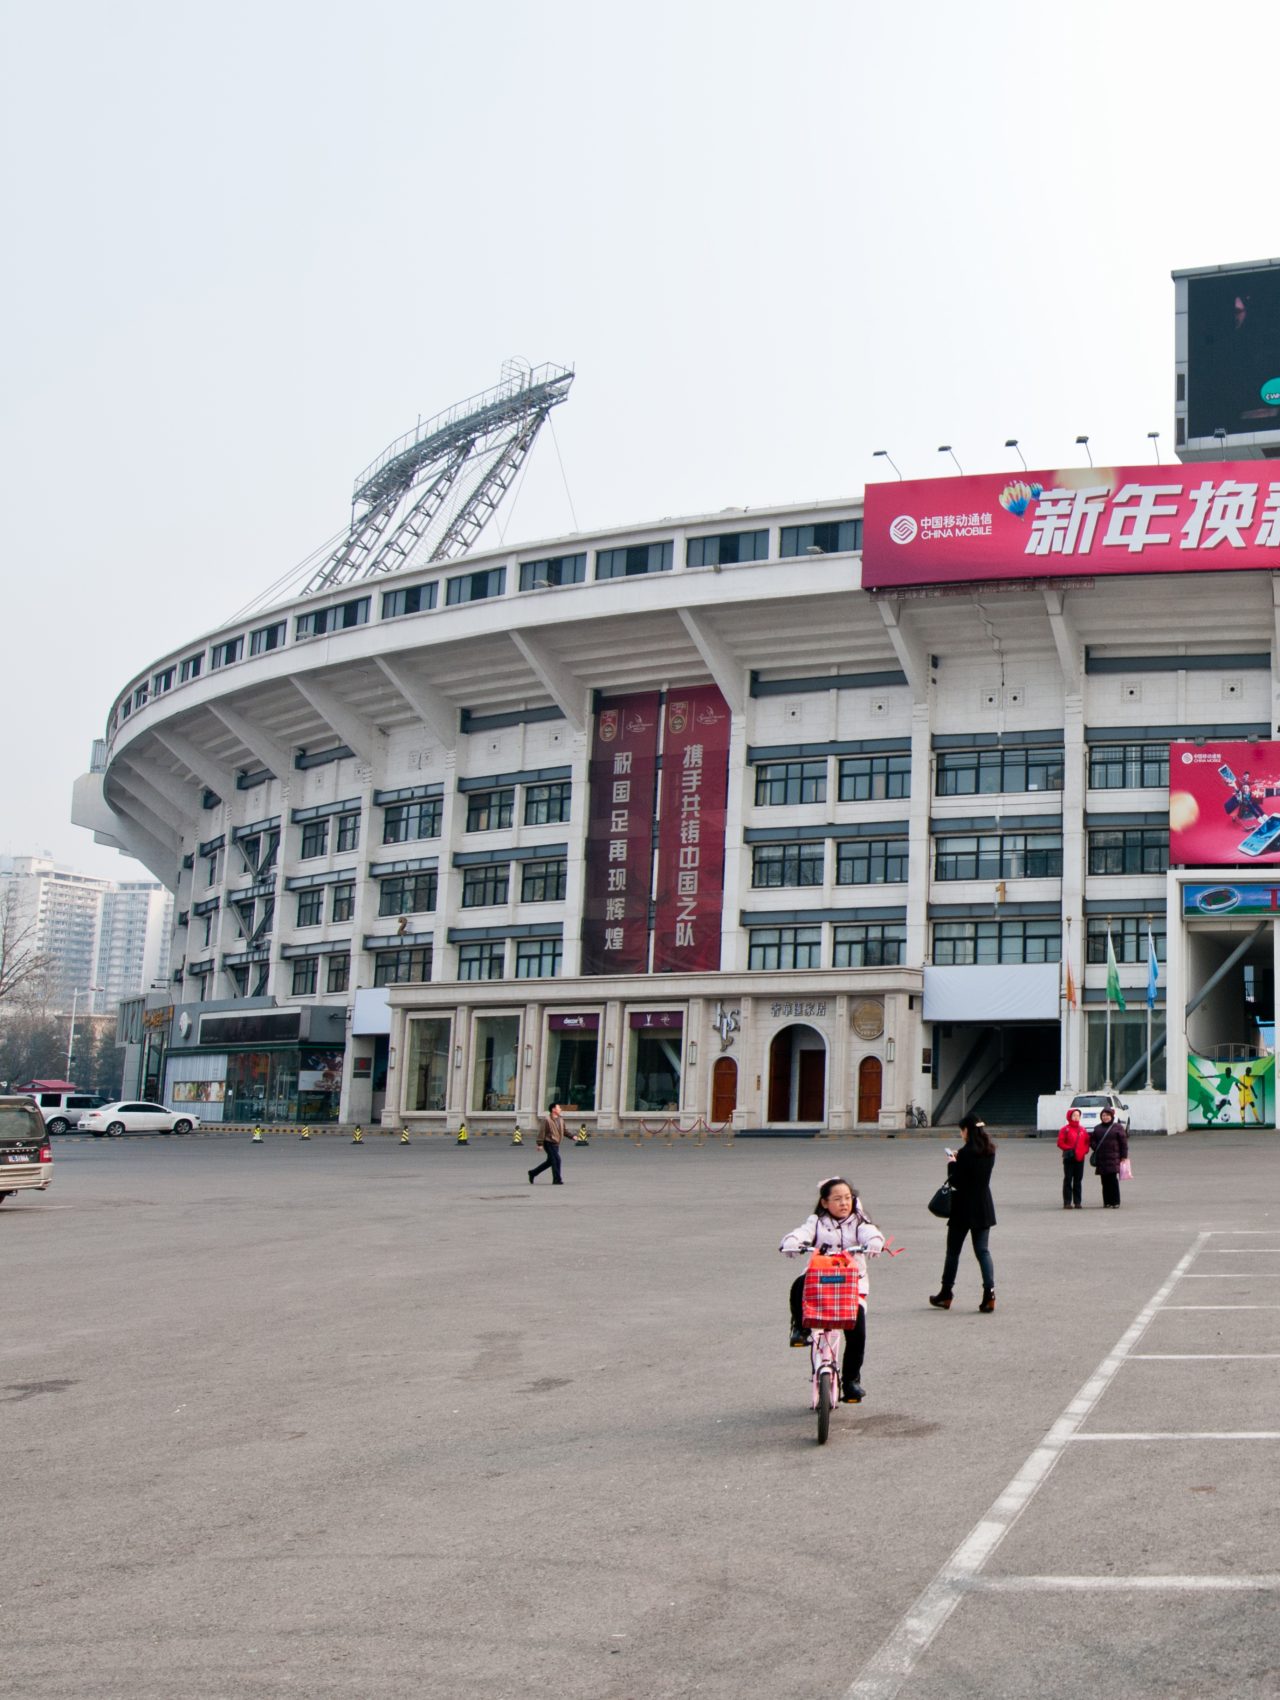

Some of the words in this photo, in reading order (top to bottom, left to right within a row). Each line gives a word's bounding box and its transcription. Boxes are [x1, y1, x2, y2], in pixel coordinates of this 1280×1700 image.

[920, 512, 992, 529] 中国移动通信
[921, 528, 953, 540] CHINA
[955, 525, 992, 537] MOBILE
[604, 751, 633, 950] 祝国足再现辉煌
[675, 744, 703, 947] 携手共铸中国之队
